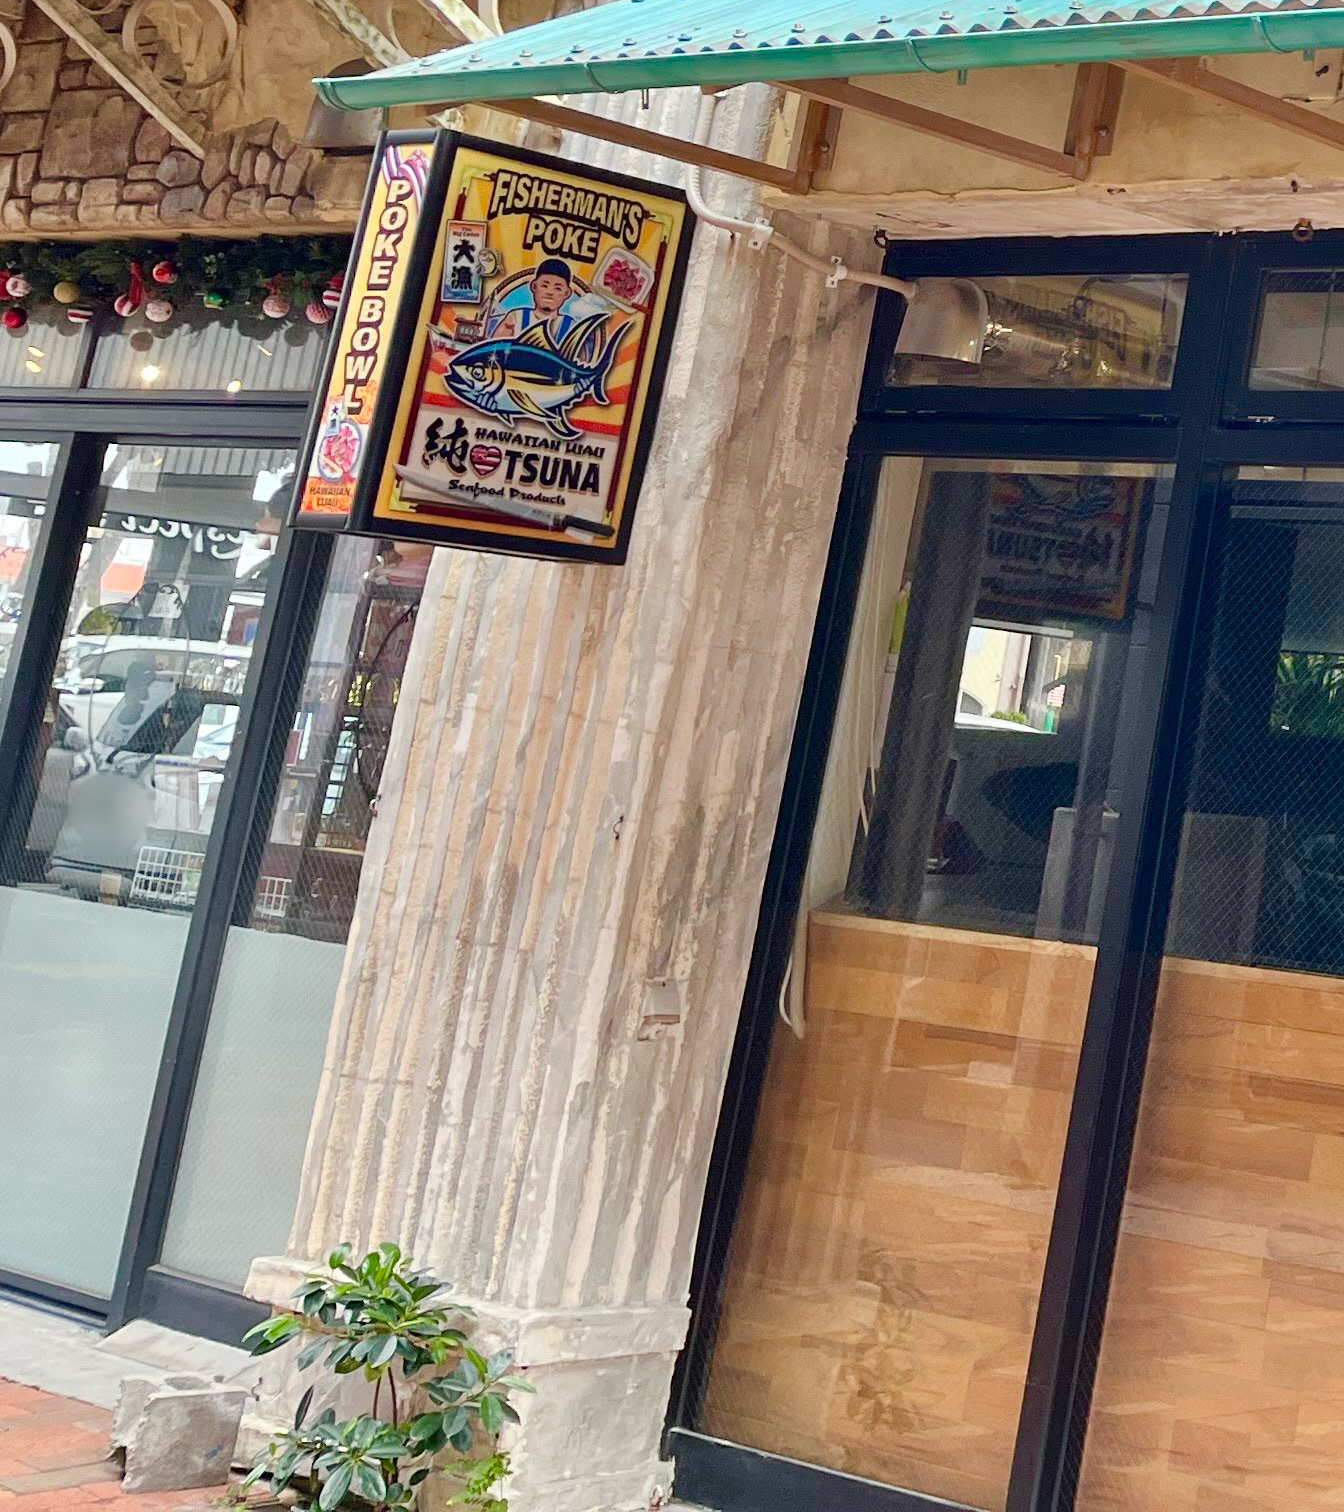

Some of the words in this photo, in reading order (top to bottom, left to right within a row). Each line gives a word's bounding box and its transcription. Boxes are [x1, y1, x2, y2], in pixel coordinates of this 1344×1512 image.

[367, 176, 413, 291] POKE
[488, 169, 645, 249] FISHERMAN'S
[523, 215, 601, 263] POKE
[344, 296, 386, 415] BOWL
[422, 417, 470, 475] 純
[504, 449, 600, 494] TSUNA
[565, 441, 606, 459] LUAU
[448, 479, 505, 498] Seafood
[509, 488, 566, 506] Products
